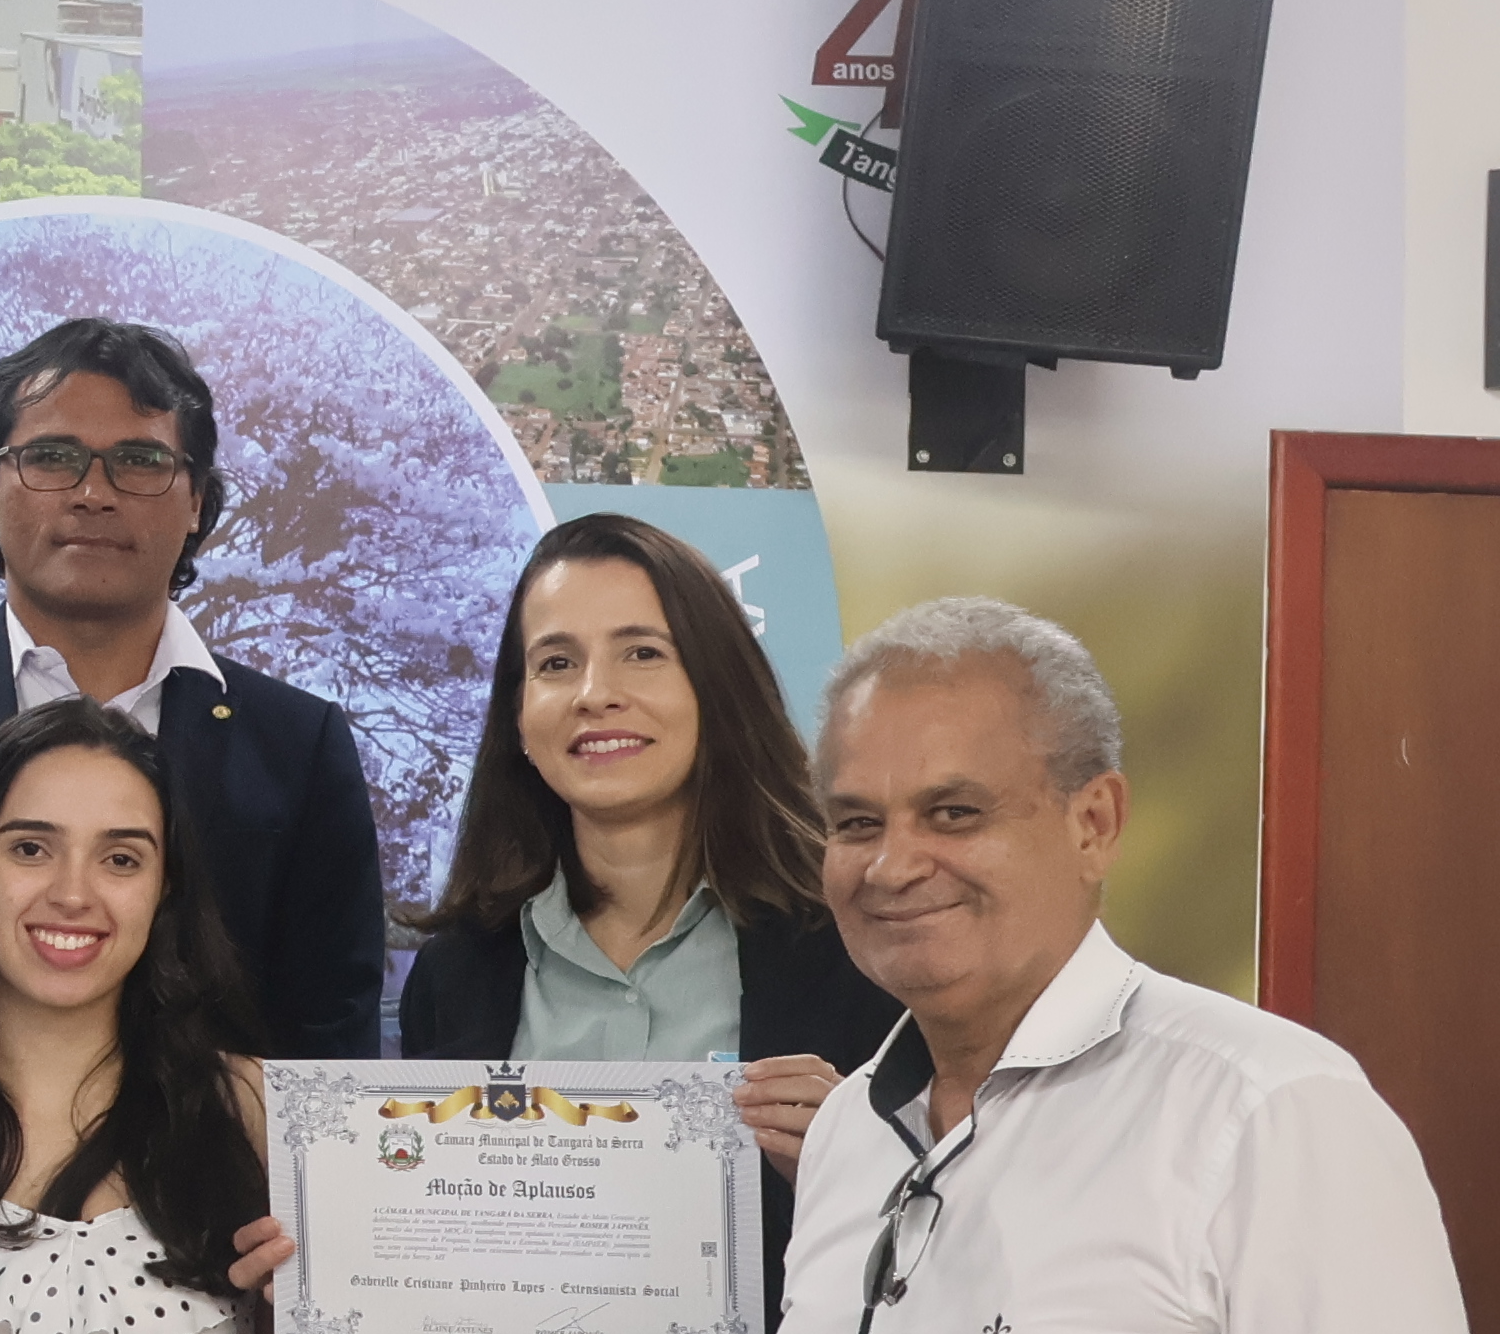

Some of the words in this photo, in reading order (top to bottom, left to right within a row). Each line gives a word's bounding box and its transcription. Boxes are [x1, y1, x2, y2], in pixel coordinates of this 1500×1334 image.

[832, 62, 895, 80] anos
[426, 1178, 482, 1200] Moção
[489, 1180, 506, 1197] de
[513, 1180, 595, 1201] Aplausos
[351, 1274, 398, 1287] Gabrielle
[404, 1277, 453, 1290] Cristiane
[460, 1278, 505, 1293] Pinheiro
[512, 1281, 544, 1294] Lopes
[561, 1282, 636, 1296] Extensionista
